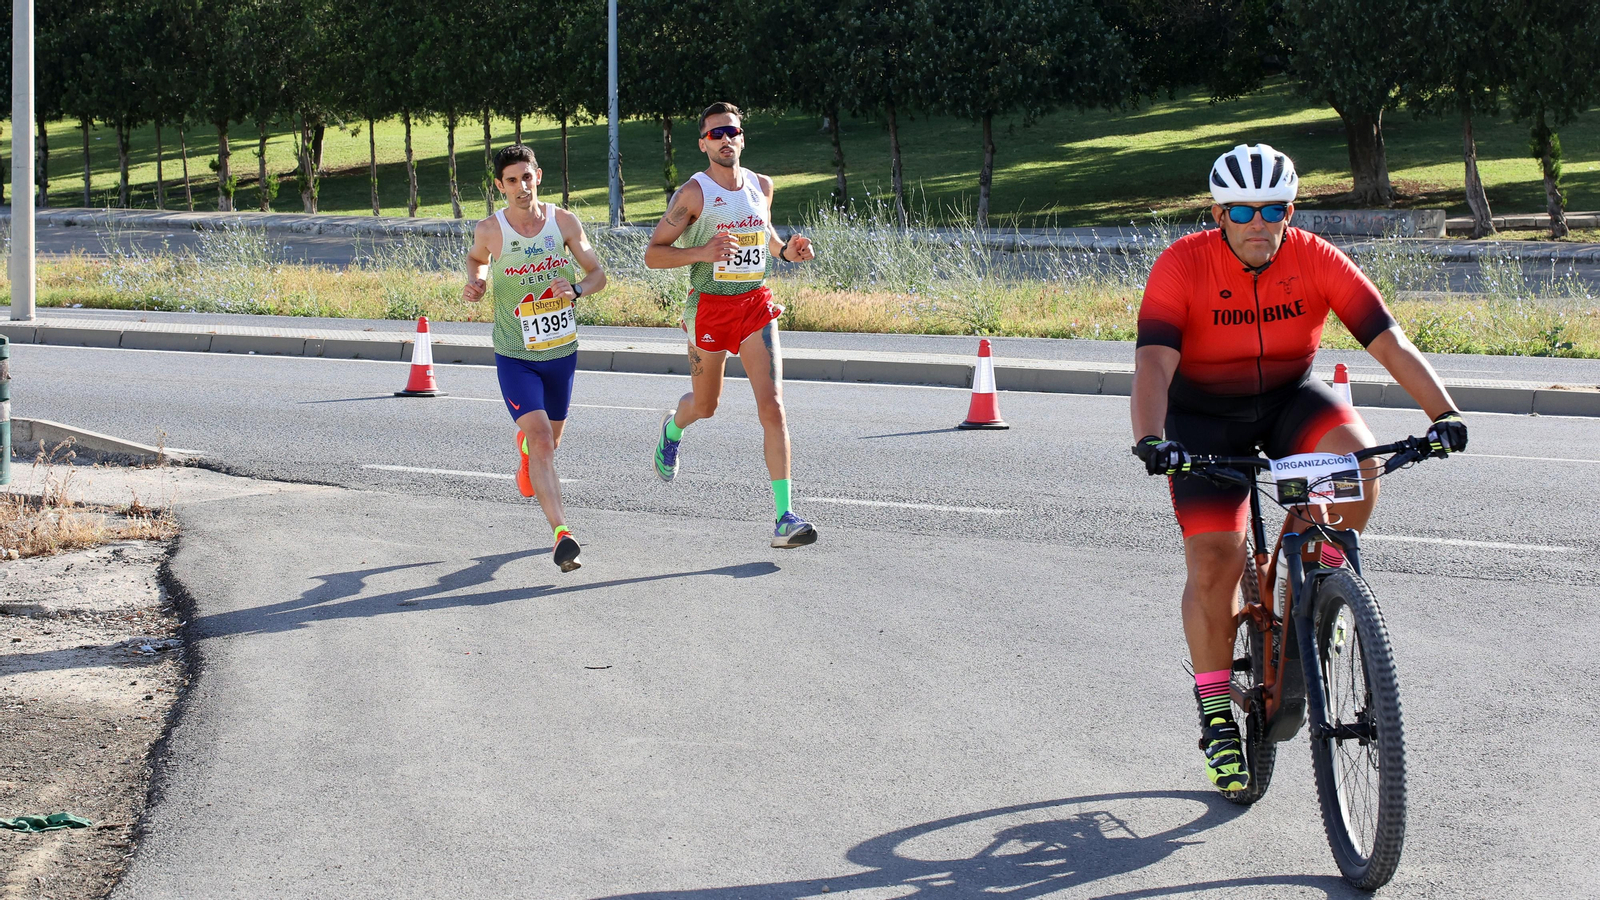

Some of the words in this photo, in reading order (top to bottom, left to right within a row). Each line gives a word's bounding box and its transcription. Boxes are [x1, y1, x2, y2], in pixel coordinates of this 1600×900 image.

[505, 254, 568, 275] maratón
[520, 270, 558, 285] JEREZ
[1212, 309, 1255, 325] TODO
[1263, 299, 1306, 322] BIKE
[532, 311, 568, 335] 1395
[1276, 457, 1352, 470] ORGANIZACIÓN
